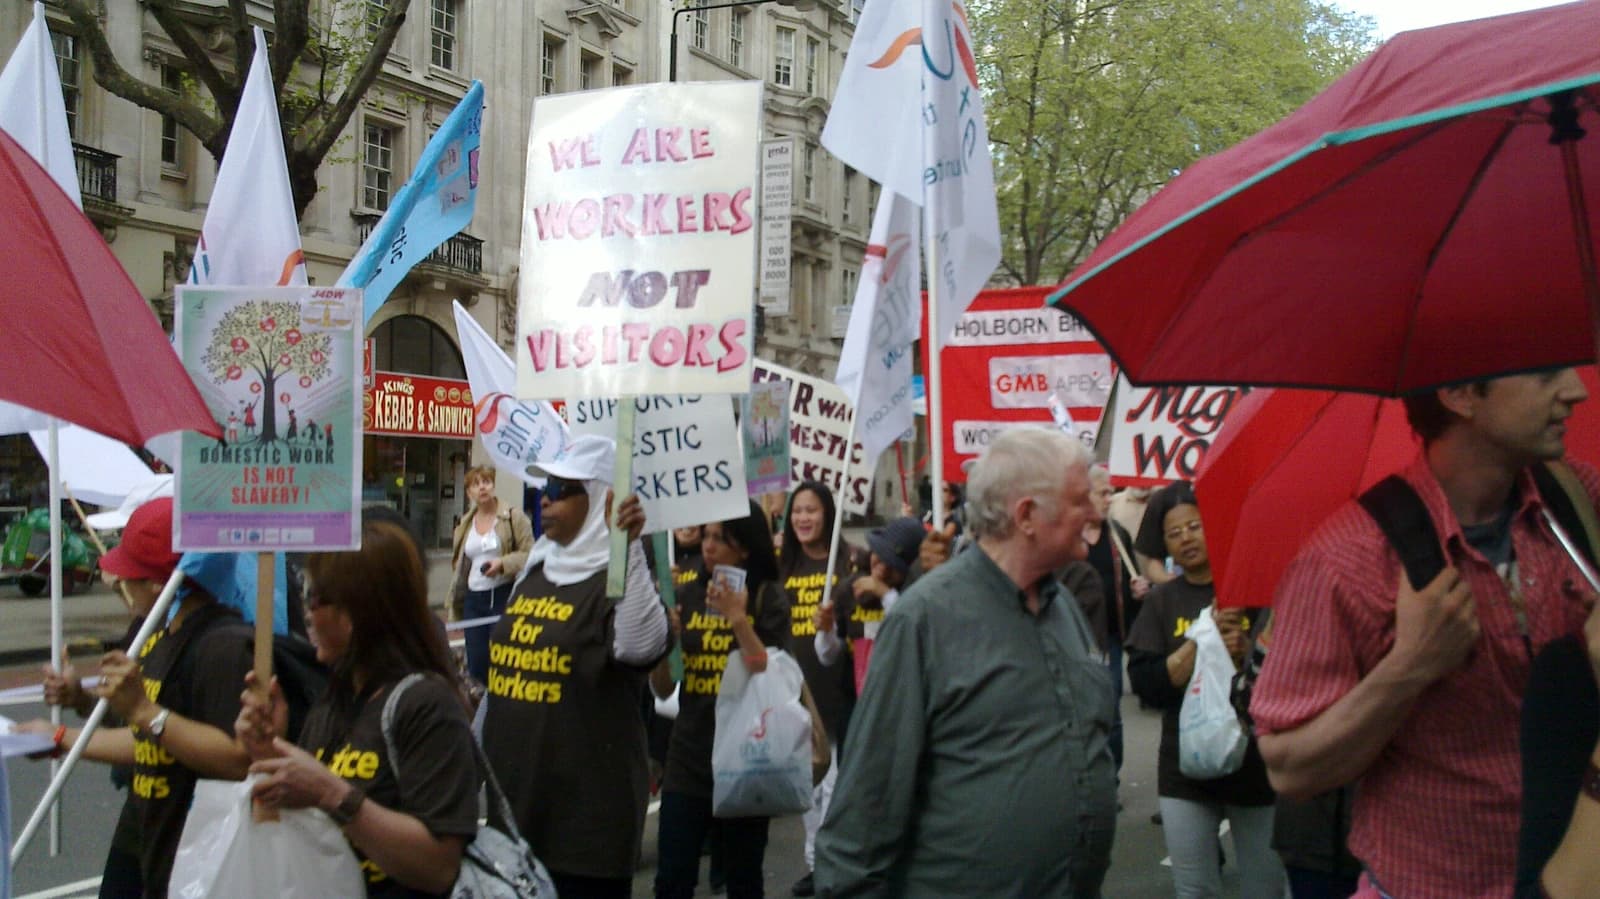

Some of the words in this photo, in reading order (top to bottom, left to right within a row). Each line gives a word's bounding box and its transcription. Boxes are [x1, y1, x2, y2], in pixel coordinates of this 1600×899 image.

[549, 133, 601, 172] WE
[621, 127, 714, 164] ARE
[533, 187, 753, 241] WORKERS
[577, 269, 711, 309] NOT
[955, 317, 1048, 337] HOLBORN
[527, 319, 748, 373] VISITORS
[383, 381, 415, 396] KINGS
[996, 374, 1049, 394] GMB
[375, 390, 414, 432] KEBAB
[417, 399, 425, 432] &
[428, 400, 473, 434] SANDWICH
[201, 448, 282, 465] DOMESTIC
[290, 447, 335, 464] WORK
[243, 468, 261, 485] IS
[265, 467, 296, 484] NOT
[232, 487, 300, 505] SLAVERY
[798, 588, 822, 604] for
[506, 594, 575, 622] Justice
[510, 616, 544, 645] for
[702, 631, 734, 651] for
